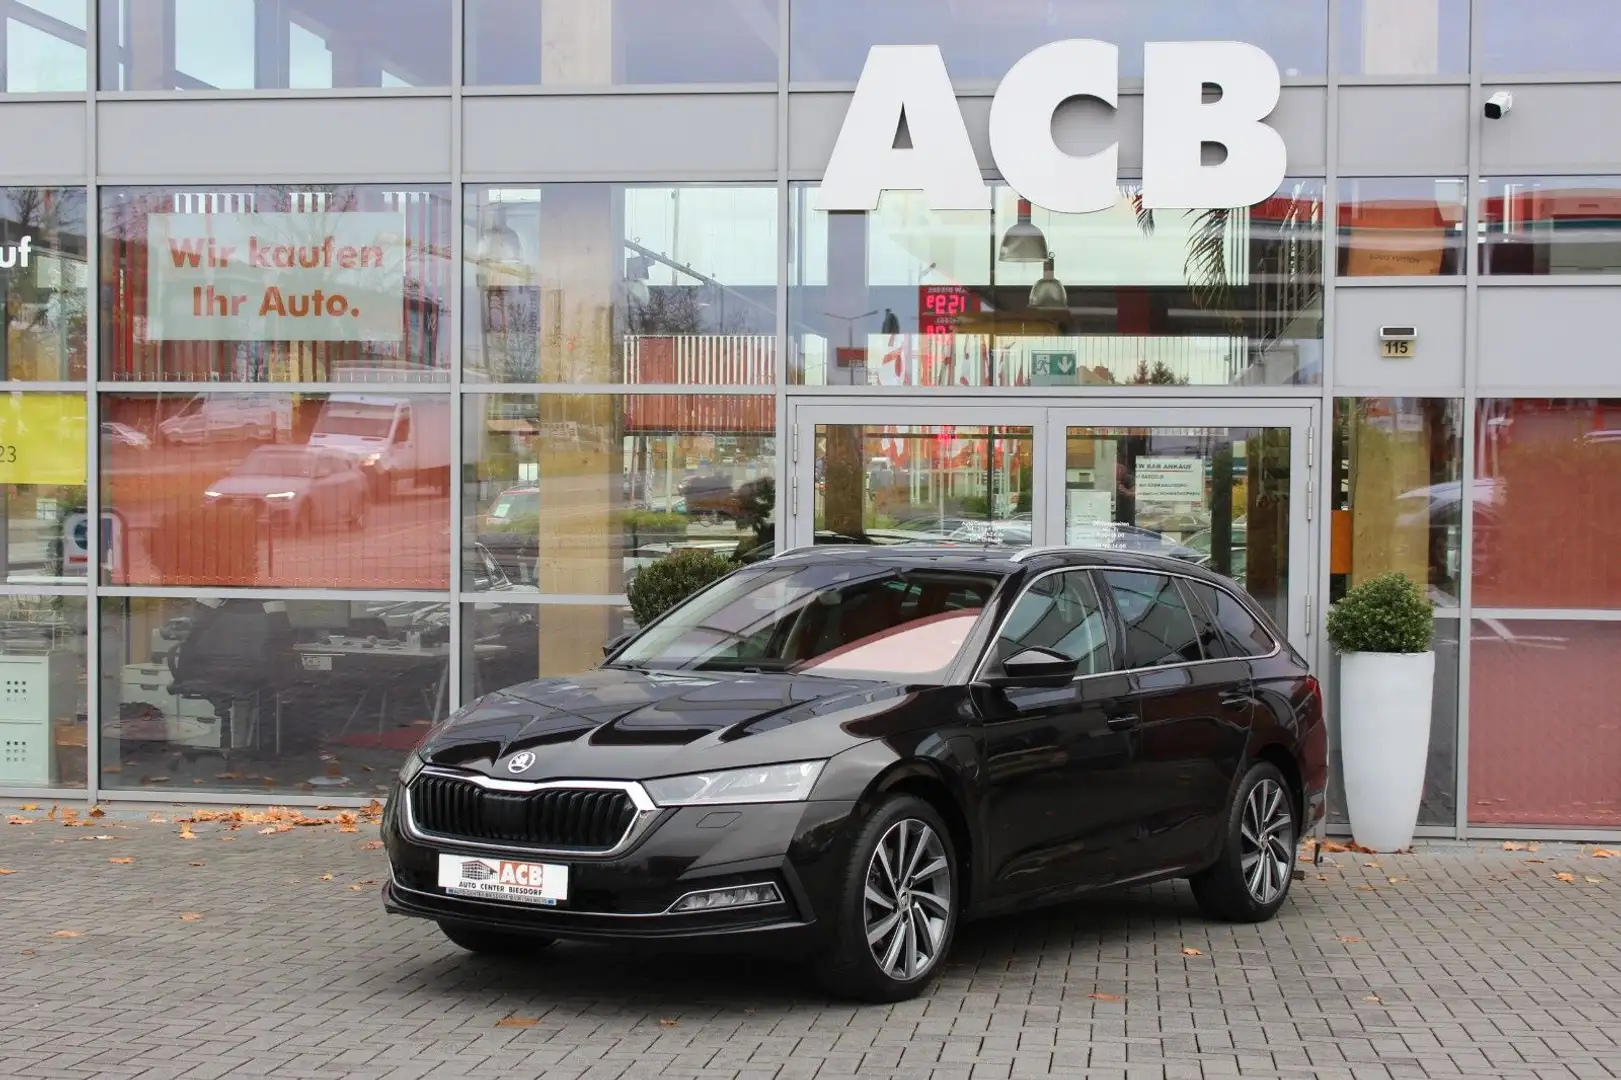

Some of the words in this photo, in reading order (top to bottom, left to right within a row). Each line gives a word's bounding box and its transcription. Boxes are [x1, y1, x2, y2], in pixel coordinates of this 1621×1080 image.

[814, 38, 1286, 214] ACB
[168, 237, 237, 268] Wir
[248, 235, 383, 268] kaufen
[193, 285, 247, 316] Ihr
[258, 286, 360, 317] Auto.
[1385, 341, 1408, 354] 115
[459, 881, 477, 889] AUTO
[480, 883, 505, 892] CENTER
[508, 886, 543, 896] BIESDORF
[500, 862, 543, 887] ACB
